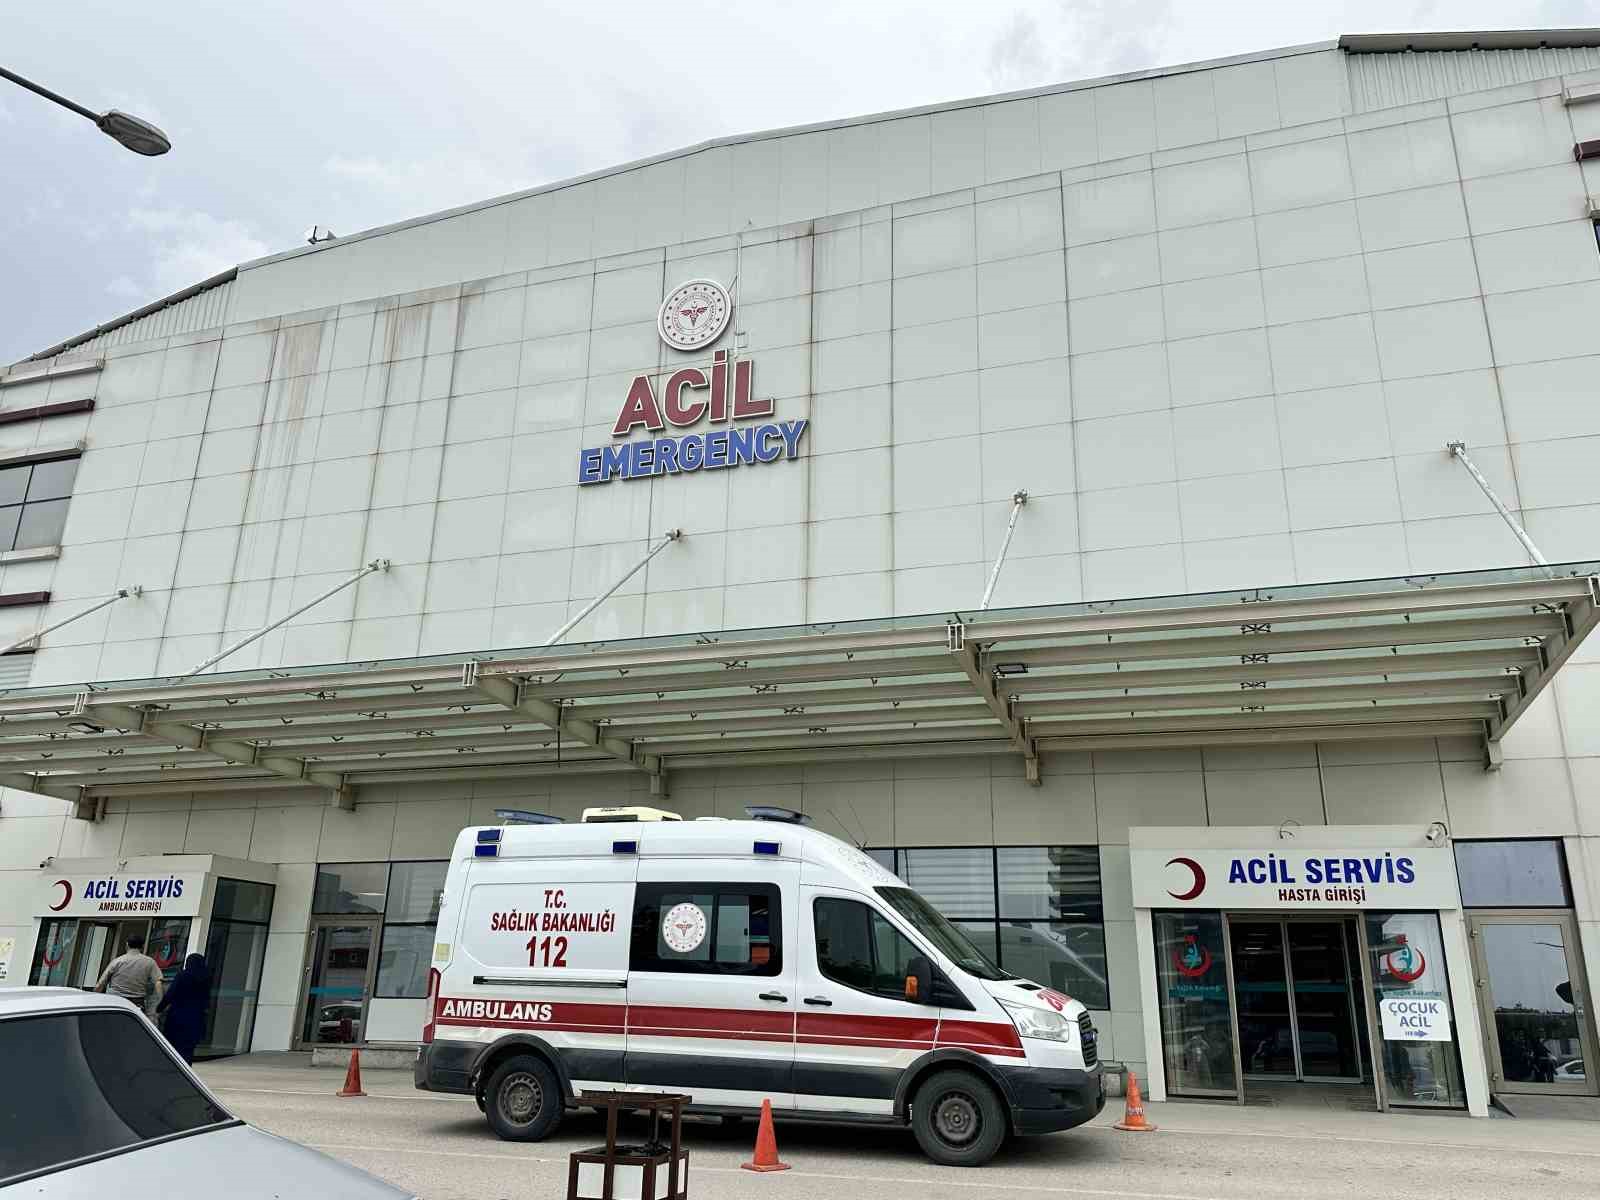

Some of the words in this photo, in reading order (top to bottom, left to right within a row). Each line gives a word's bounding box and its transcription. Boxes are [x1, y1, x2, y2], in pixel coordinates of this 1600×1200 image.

[612, 348, 775, 436] ACİL
[577, 418, 809, 486] EMERGENCY
[1228, 853, 1296, 884] ACİL
[1305, 852, 1416, 884] SERVİS
[84, 876, 120, 899] ACİL
[125, 875, 184, 899] SERVİS
[1278, 888, 1321, 902] HASTA
[1325, 886, 1366, 904] GİRİŞİ
[98, 901, 138, 912] AMBULANS
[544, 889, 567, 909] T.C.
[491, 908, 540, 932] SAĞLIK
[542, 908, 616, 933] BAKANLIĞI
[526, 935, 568, 968] 112
[442, 999, 553, 1022] AMBULANS
[1388, 1002, 1439, 1017] ÇOCUK
[1400, 1013, 1432, 1028] ACİL
